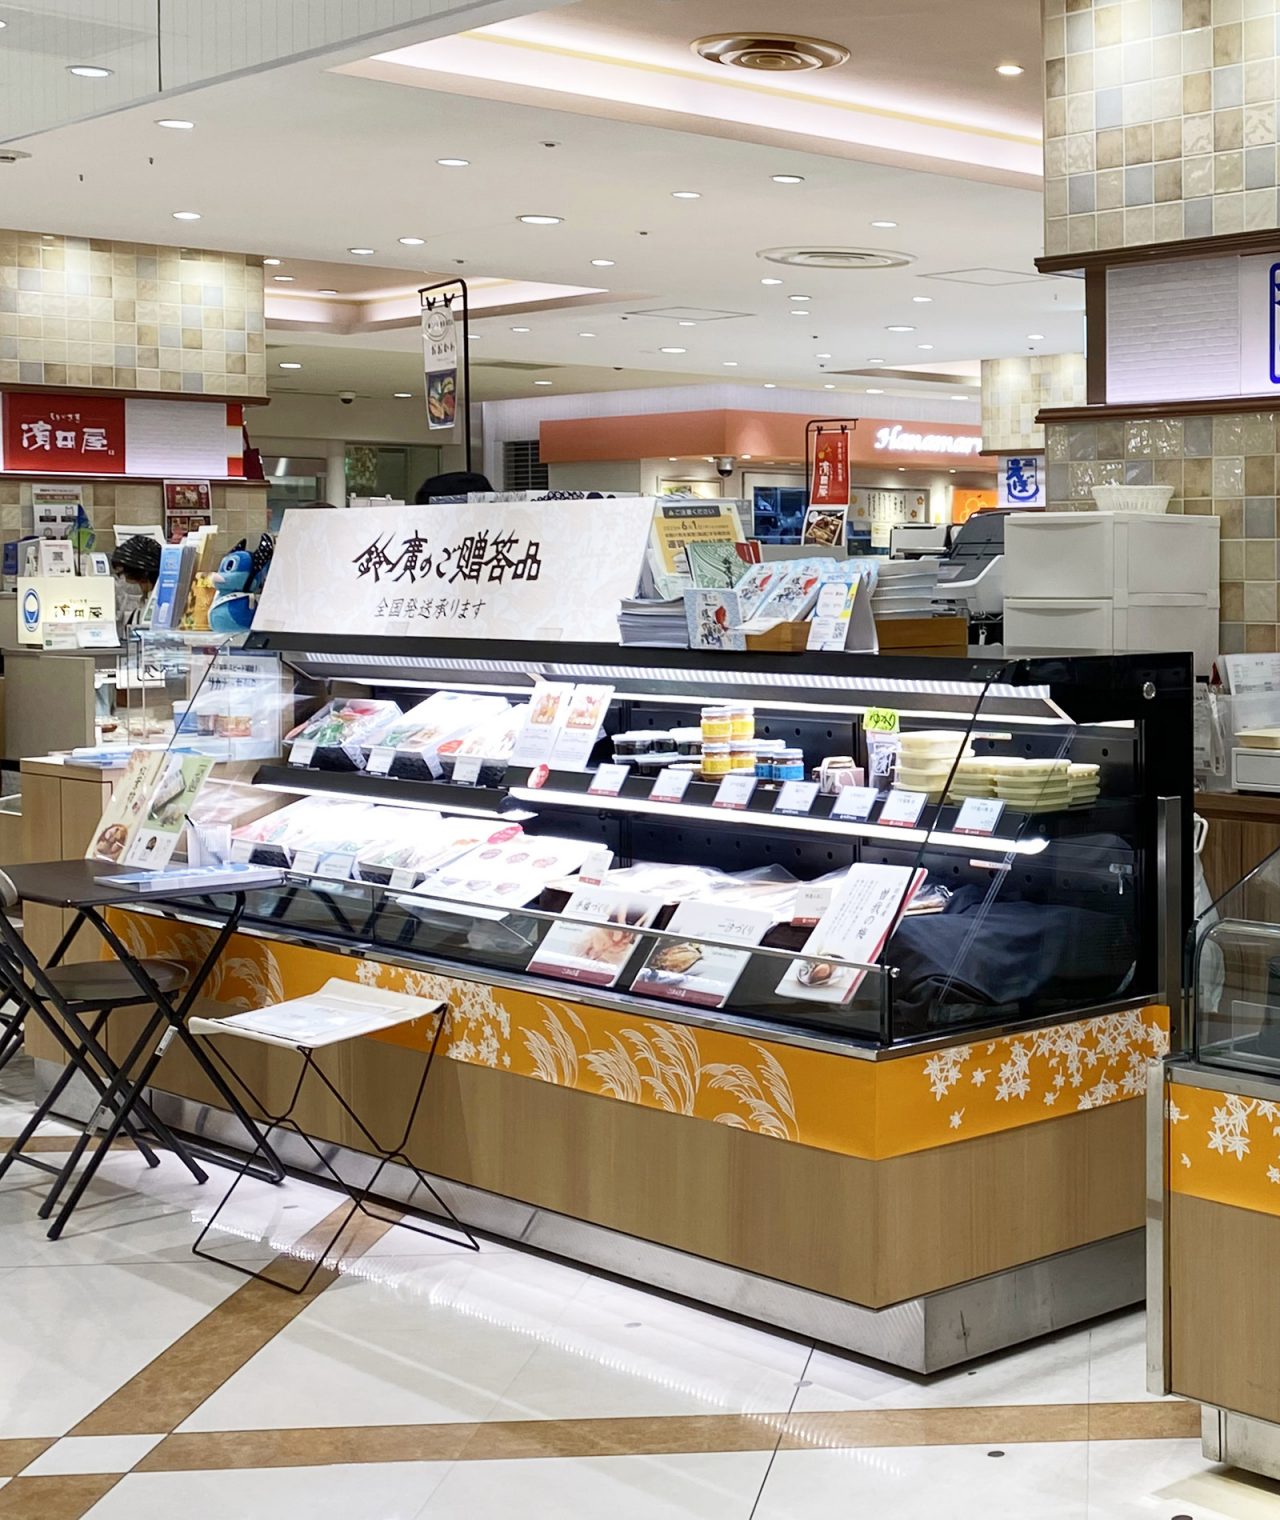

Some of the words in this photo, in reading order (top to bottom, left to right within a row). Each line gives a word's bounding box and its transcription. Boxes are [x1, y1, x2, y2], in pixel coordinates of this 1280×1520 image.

[21, 420, 108, 453] 濱田屋
[874, 425, 982, 455] Hanamar
[352, 529, 542, 584] 鈴廣のご贈答品
[374, 597, 487, 620] 全国発送承ります
